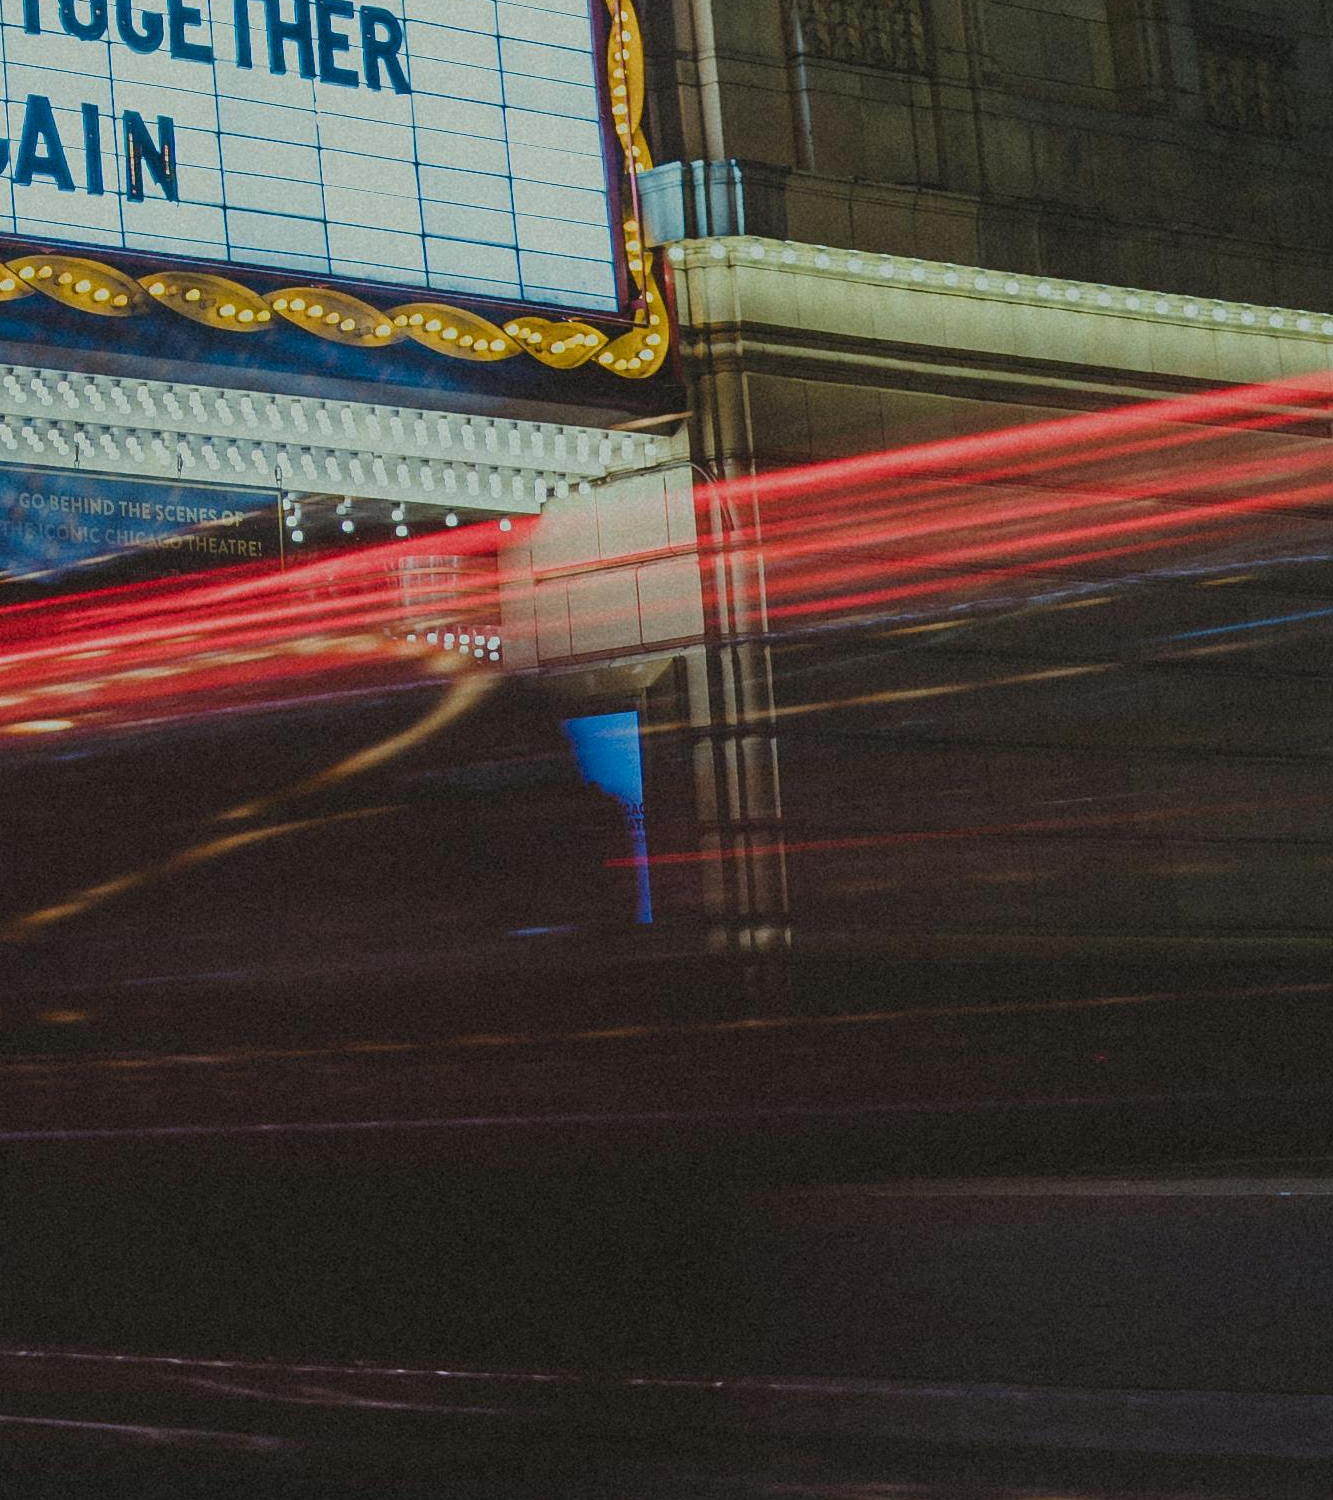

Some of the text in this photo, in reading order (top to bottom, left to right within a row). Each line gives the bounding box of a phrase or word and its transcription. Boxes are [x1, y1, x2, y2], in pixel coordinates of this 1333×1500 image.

[19, 492, 246, 527] GO BEHIND THE SCENES OF
[3, 519, 263, 558] THE ICONIC CHICAGO THEATRE!
